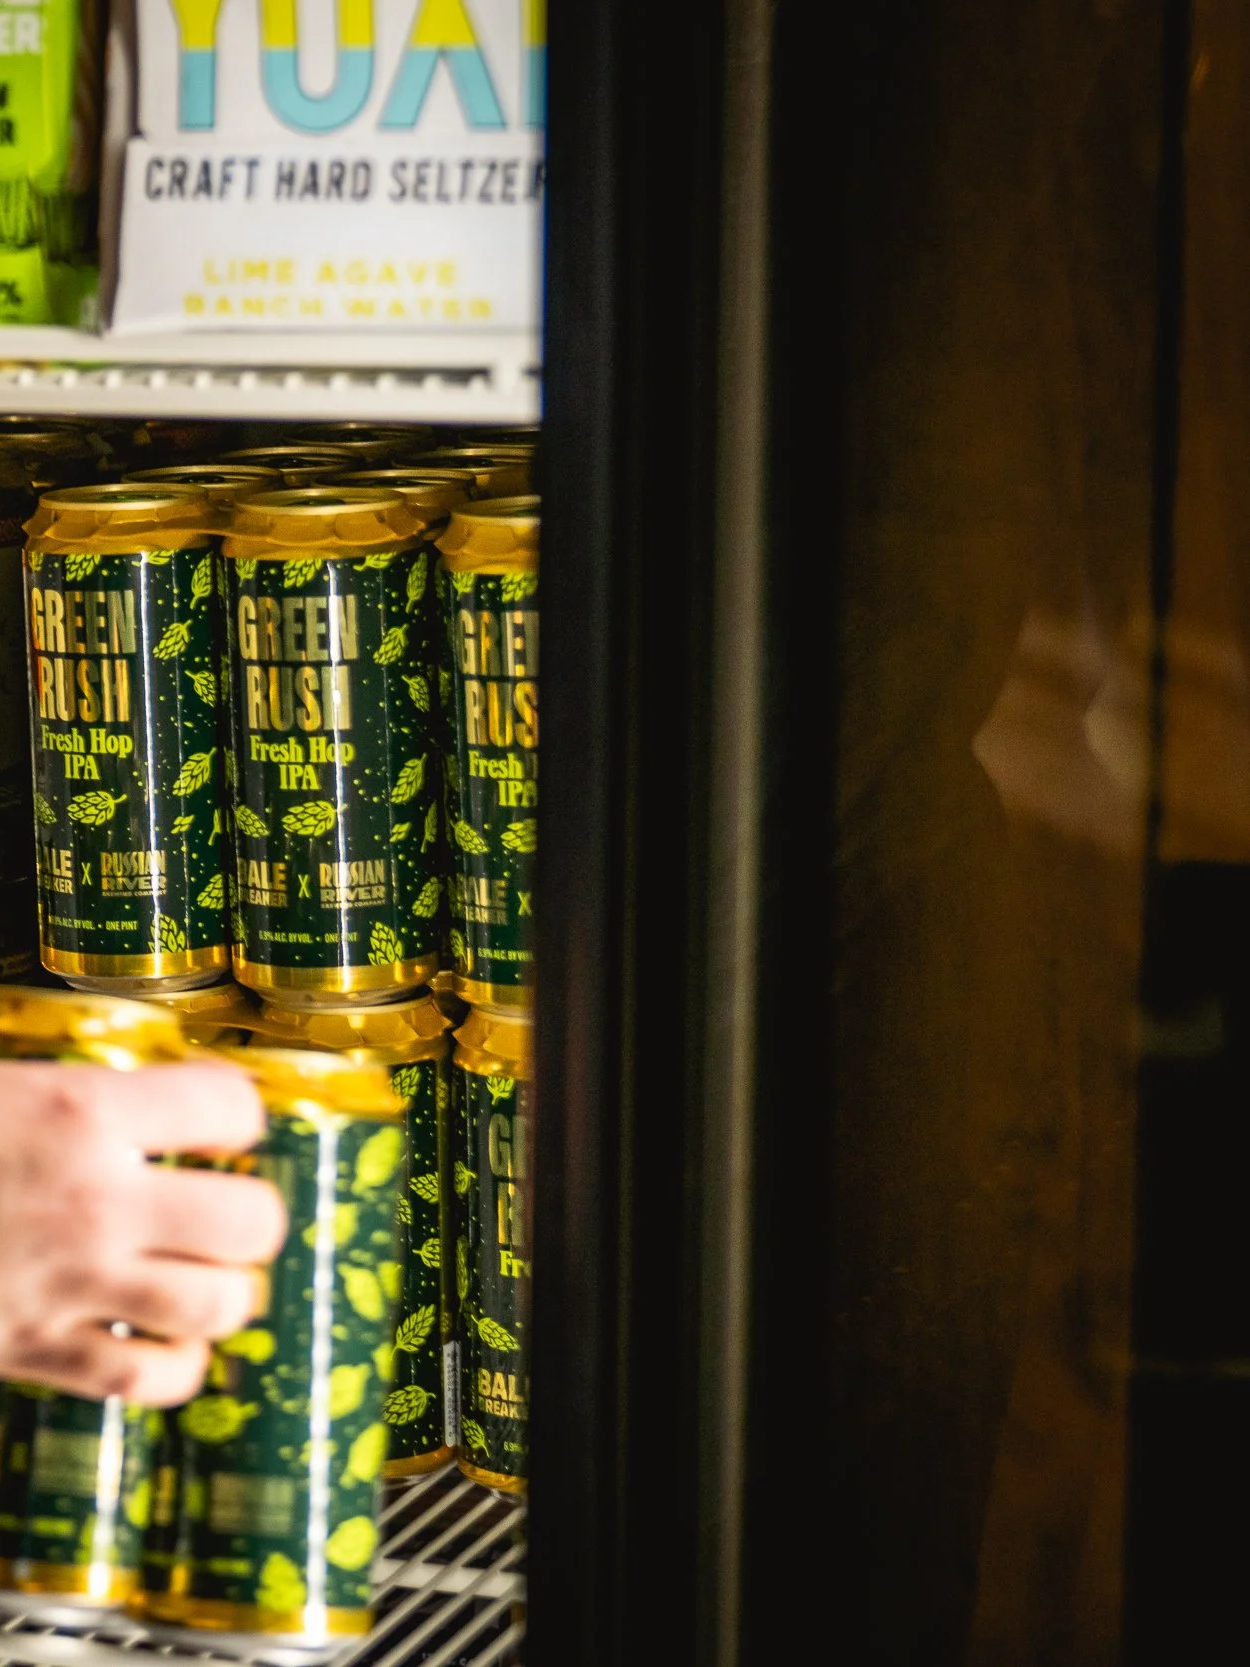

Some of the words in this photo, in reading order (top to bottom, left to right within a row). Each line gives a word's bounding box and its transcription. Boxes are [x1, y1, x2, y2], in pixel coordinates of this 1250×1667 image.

[145, 156, 260, 202] CRAFT
[275, 156, 372, 203] HARD
[389, 156, 546, 204] SELTZER
[203, 258, 296, 286] LIME
[316, 257, 458, 286] AGAVE
[183, 293, 325, 317] RANCH
[348, 293, 493, 320] WATER
[31, 587, 137, 655] GREEN
[237, 594, 360, 662] GREEN
[37, 655, 130, 723] RUSH
[246, 664, 354, 732] RUSH
[464, 679, 539, 748] RUS
[40, 724, 85, 753] Fresh
[89, 727, 134, 758] Hop
[250, 735, 305, 763] Fresh
[309, 736, 357, 767] Hop
[62, 754, 100, 780] IPA
[278, 764, 321, 790] IPA
[468, 750, 524, 780] Fresh
[101, 849, 167, 876] RUSSIAN
[318, 859, 387, 888] RUSSIAN
[101, 876, 168, 891] RIVER
[319, 884, 387, 902] RIVER
[74, 917, 82, 930] BY
[82, 918, 96, 931] VOL.
[105, 921, 120, 931] ONE
[121, 920, 138, 931] PINT
[288, 931, 297, 944] BY
[297, 931, 313, 944] VOL.
[324, 931, 339, 944] ONE
[507, 949, 517, 962] BY
